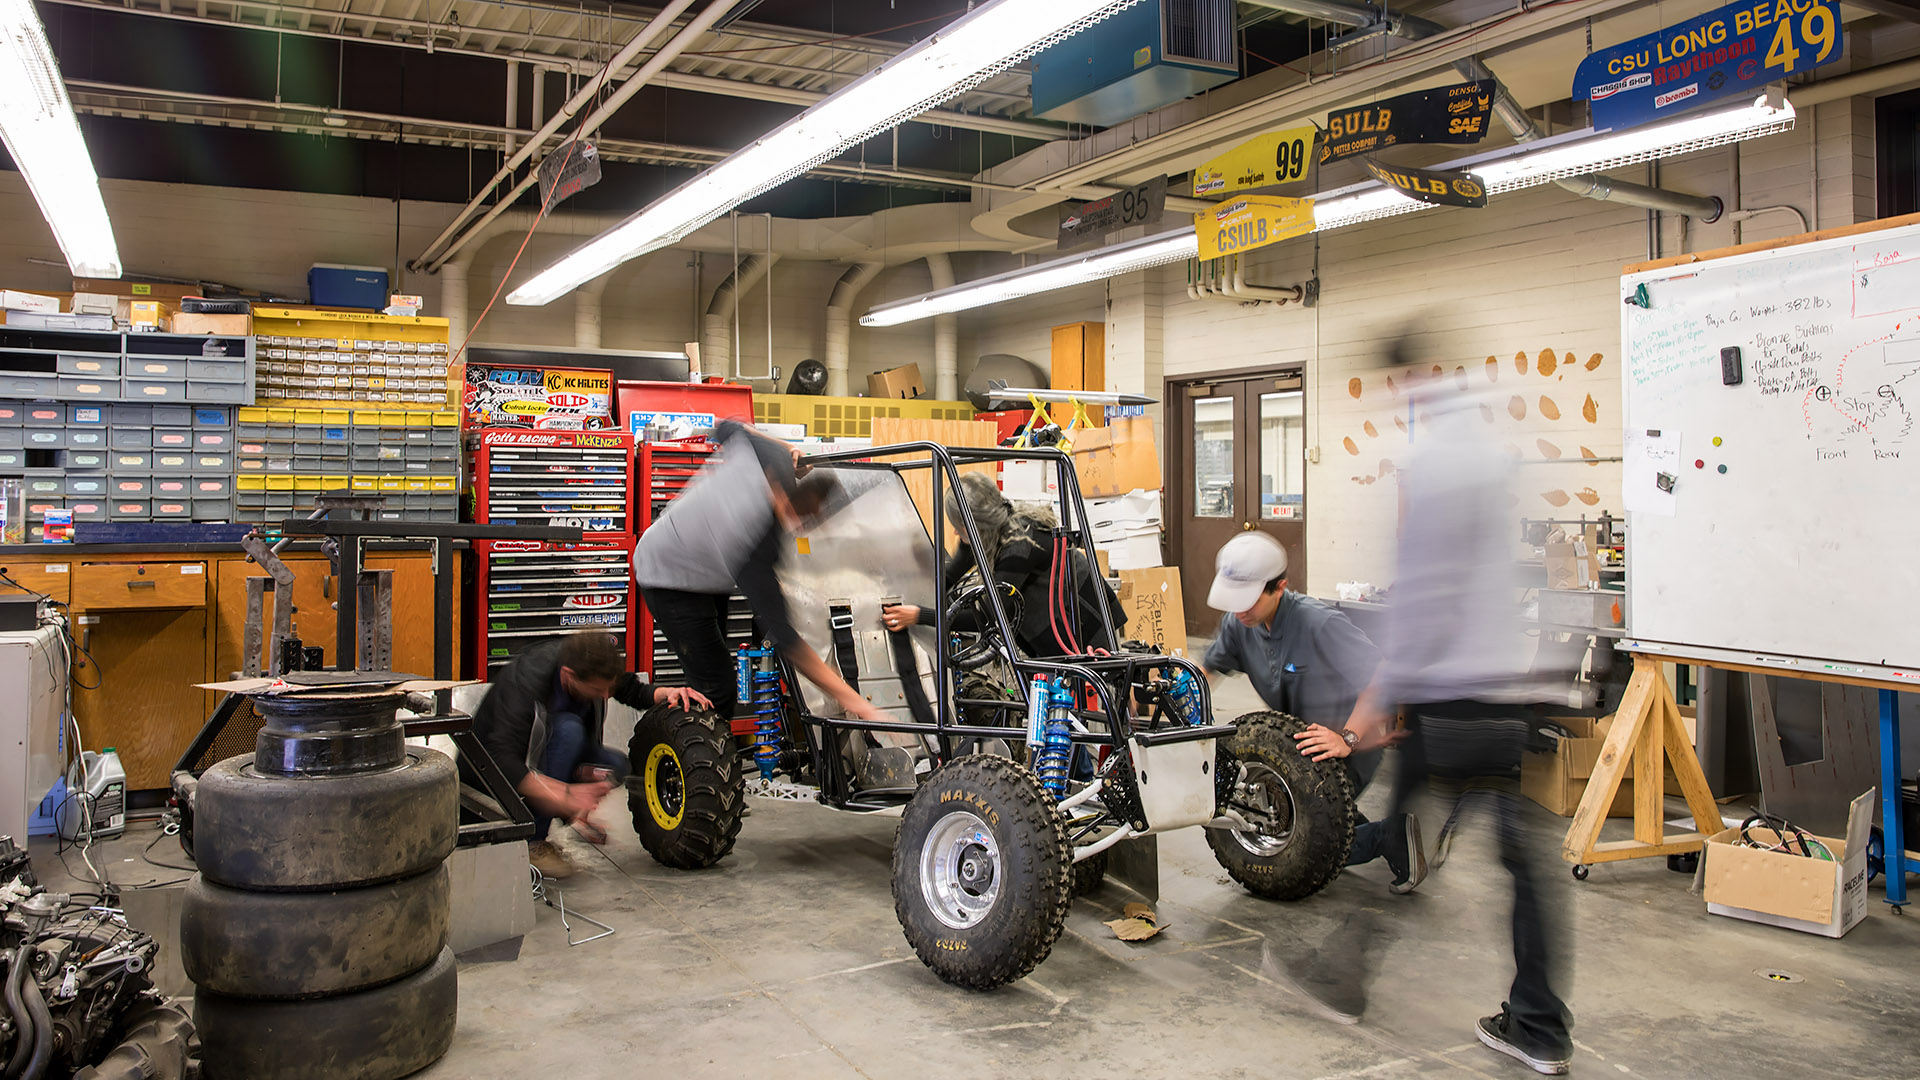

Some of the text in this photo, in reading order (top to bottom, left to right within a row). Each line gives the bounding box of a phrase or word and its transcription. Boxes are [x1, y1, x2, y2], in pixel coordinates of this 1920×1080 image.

[1608, 50, 1649, 75] CSU
[1657, 20, 1727, 64] LONG
[1764, 5, 1836, 73] 49
[1653, 37, 1756, 86] Raytheon
[1448, 85, 1477, 97] DENSO
[1591, 75, 1651, 95] CHASSIS SHOP
[1665, 87, 1697, 103] brembo
[1324, 108, 1393, 144] SULB
[1448, 116, 1482, 135] SAE
[1276, 139, 1304, 181] 99
[1121, 186, 1150, 225] 95
[1218, 218, 1268, 252] CSULB
[1785, 298, 1810, 313] 382
[1813, 296, 1832, 309] lbs
[548, 374, 561, 390] KC
[565, 378, 576, 387] KC
[546, 395, 589, 407] SOLID
[1843, 396, 1875, 414] Stop
[518, 434, 557, 446] RACING
[1816, 448, 1901, 461] Front Rear
[1273, 506, 1292, 516] NO EXIT
[571, 593, 618, 606] SOLID
[1154, 610, 1166, 651] BLICK
[1235, 746, 1289, 775] MAXXIS
[940, 789, 1000, 826] MAXXIS
